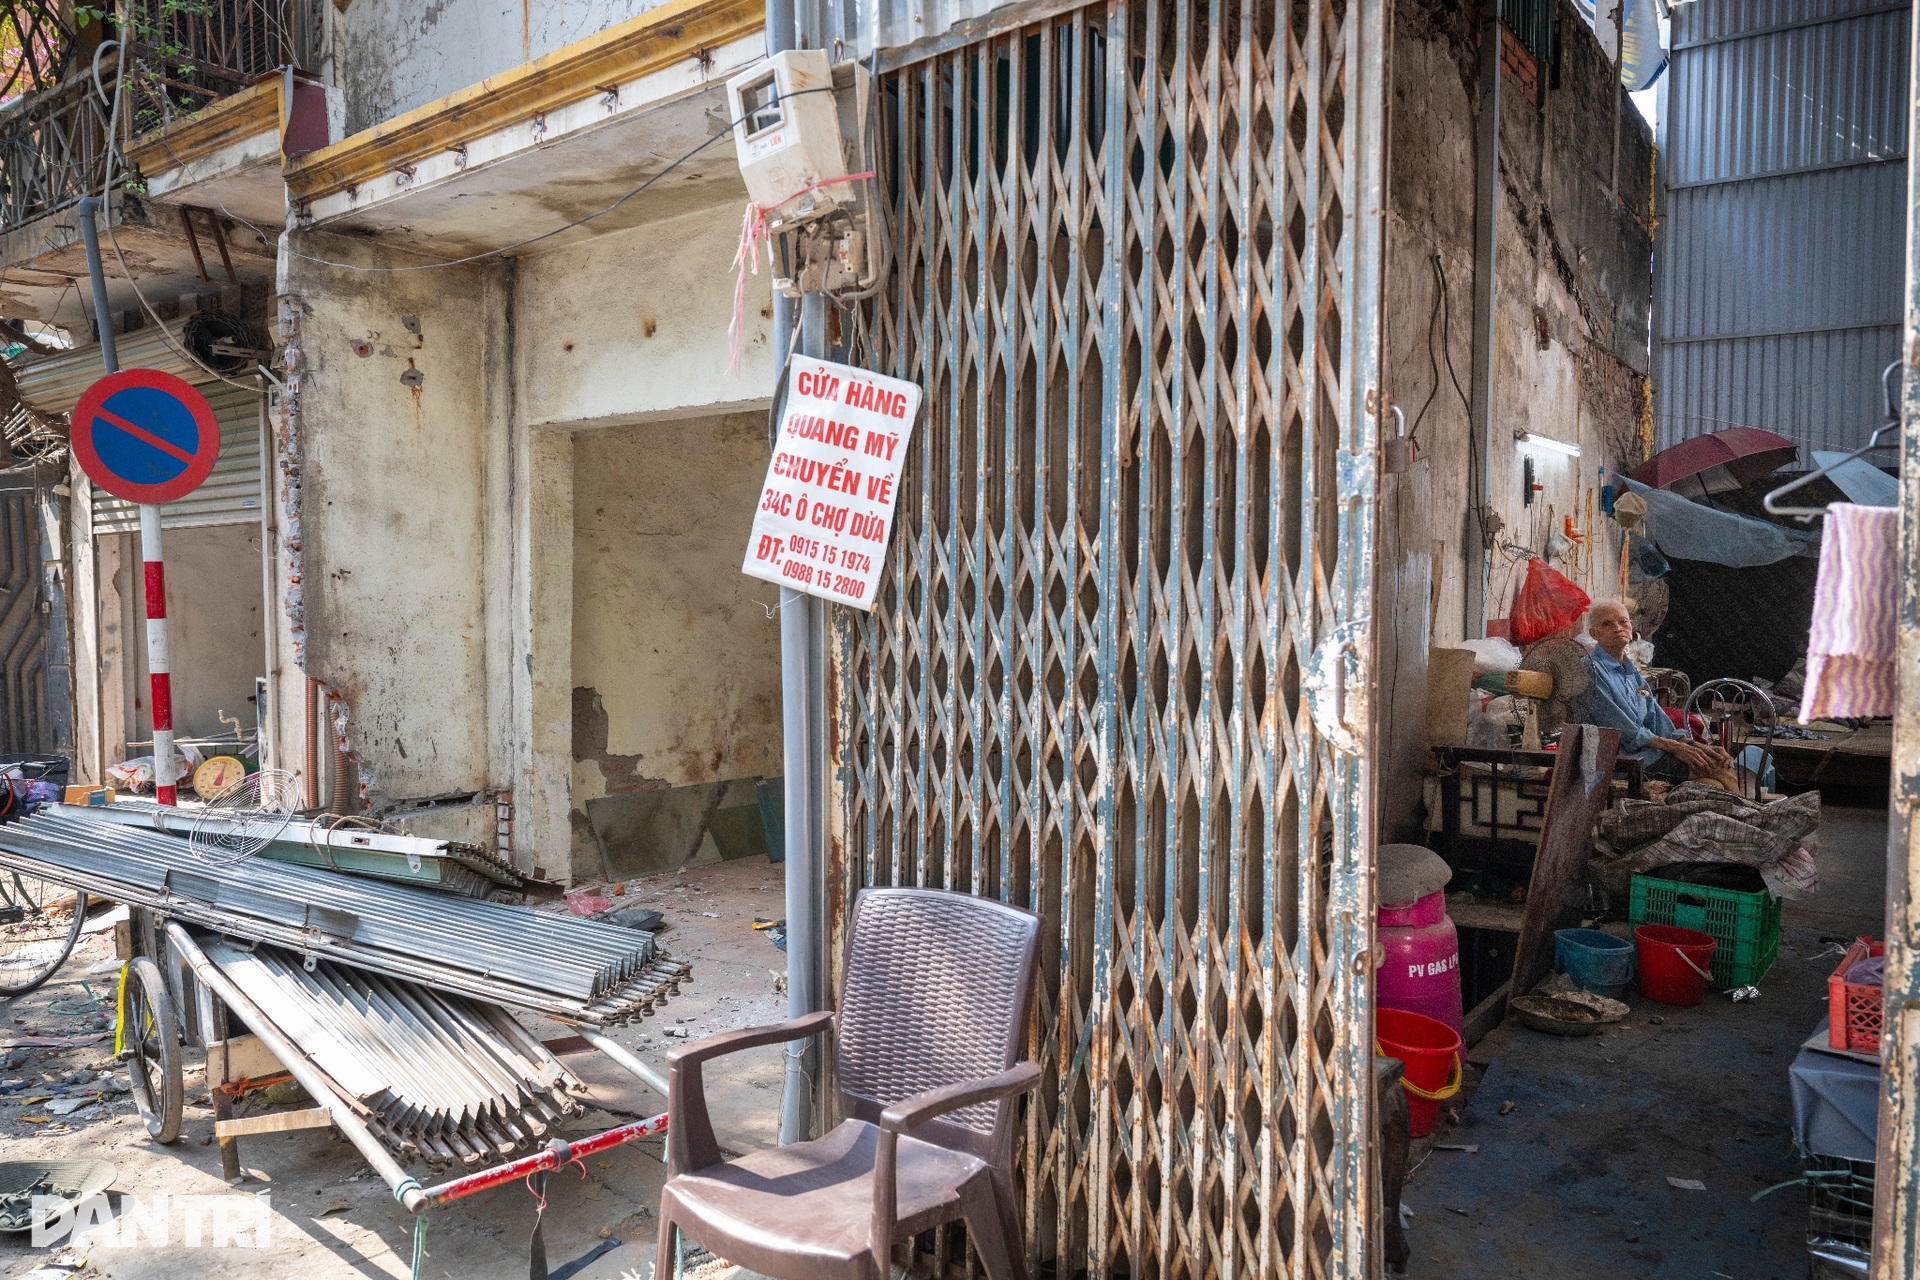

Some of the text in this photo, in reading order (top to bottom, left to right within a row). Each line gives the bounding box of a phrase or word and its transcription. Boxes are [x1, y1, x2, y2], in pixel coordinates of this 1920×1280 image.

[798, 366, 907, 419] CỬA HÀNG
[787, 412, 899, 461] QUANG MỸ
[773, 452, 894, 505] CHUYỂN VỀ
[761, 488, 885, 543] 34C Ô CHỢ DỪA
[756, 534, 871, 574] ĐT: 0915 15 1974
[782, 559, 865, 599] 0988 15 2800
[1409, 965, 1424, 978] PV
[1427, 959, 1447, 976] GAS
